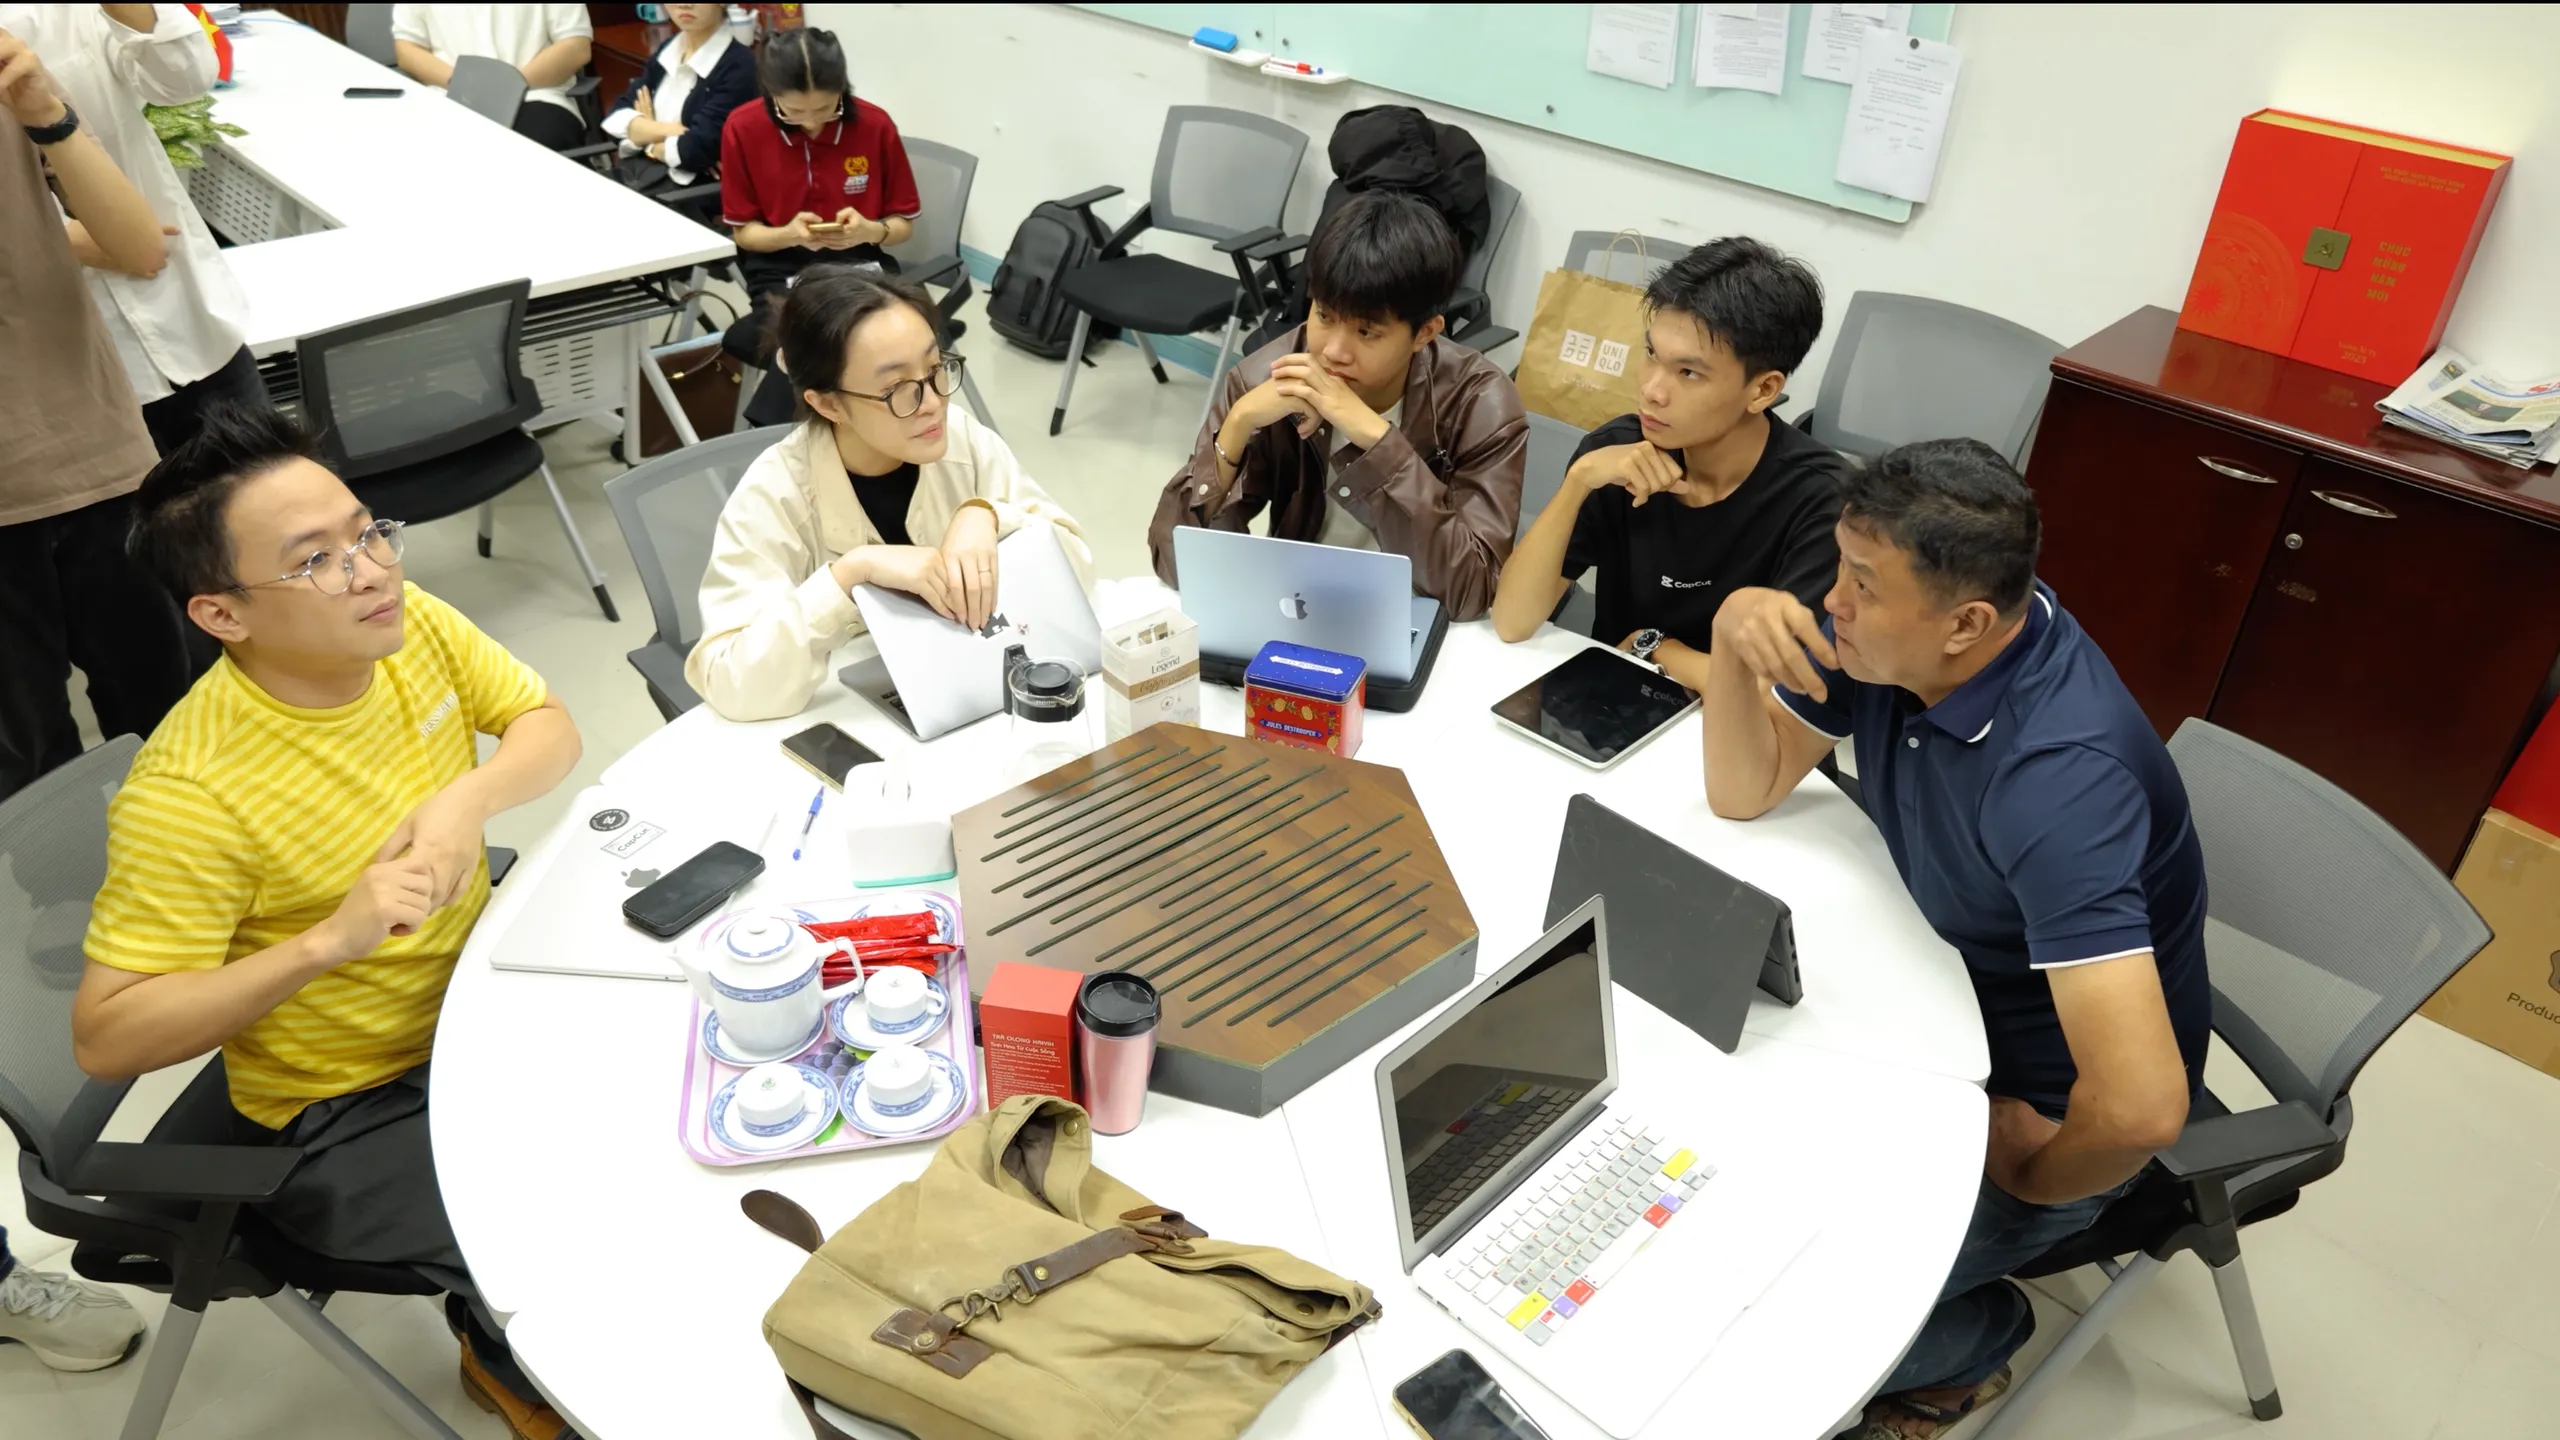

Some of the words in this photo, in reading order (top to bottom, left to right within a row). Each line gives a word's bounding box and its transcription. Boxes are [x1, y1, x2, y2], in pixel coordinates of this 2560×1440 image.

[2379, 240, 2412, 257] CHÚC
[1603, 344, 1624, 359] UNI
[1598, 357, 1621, 372] QLO
[1674, 580, 1712, 589] CapCut
[1151, 656, 1181, 675] Legend
[1265, 721, 1282, 731] JULES
[1283, 724, 1317, 737] DESTROOPER
[617, 828, 650, 852] CapCut
[992, 1033, 1005, 1042] TRÀ
[1040, 1046, 1056, 1056] Sống
